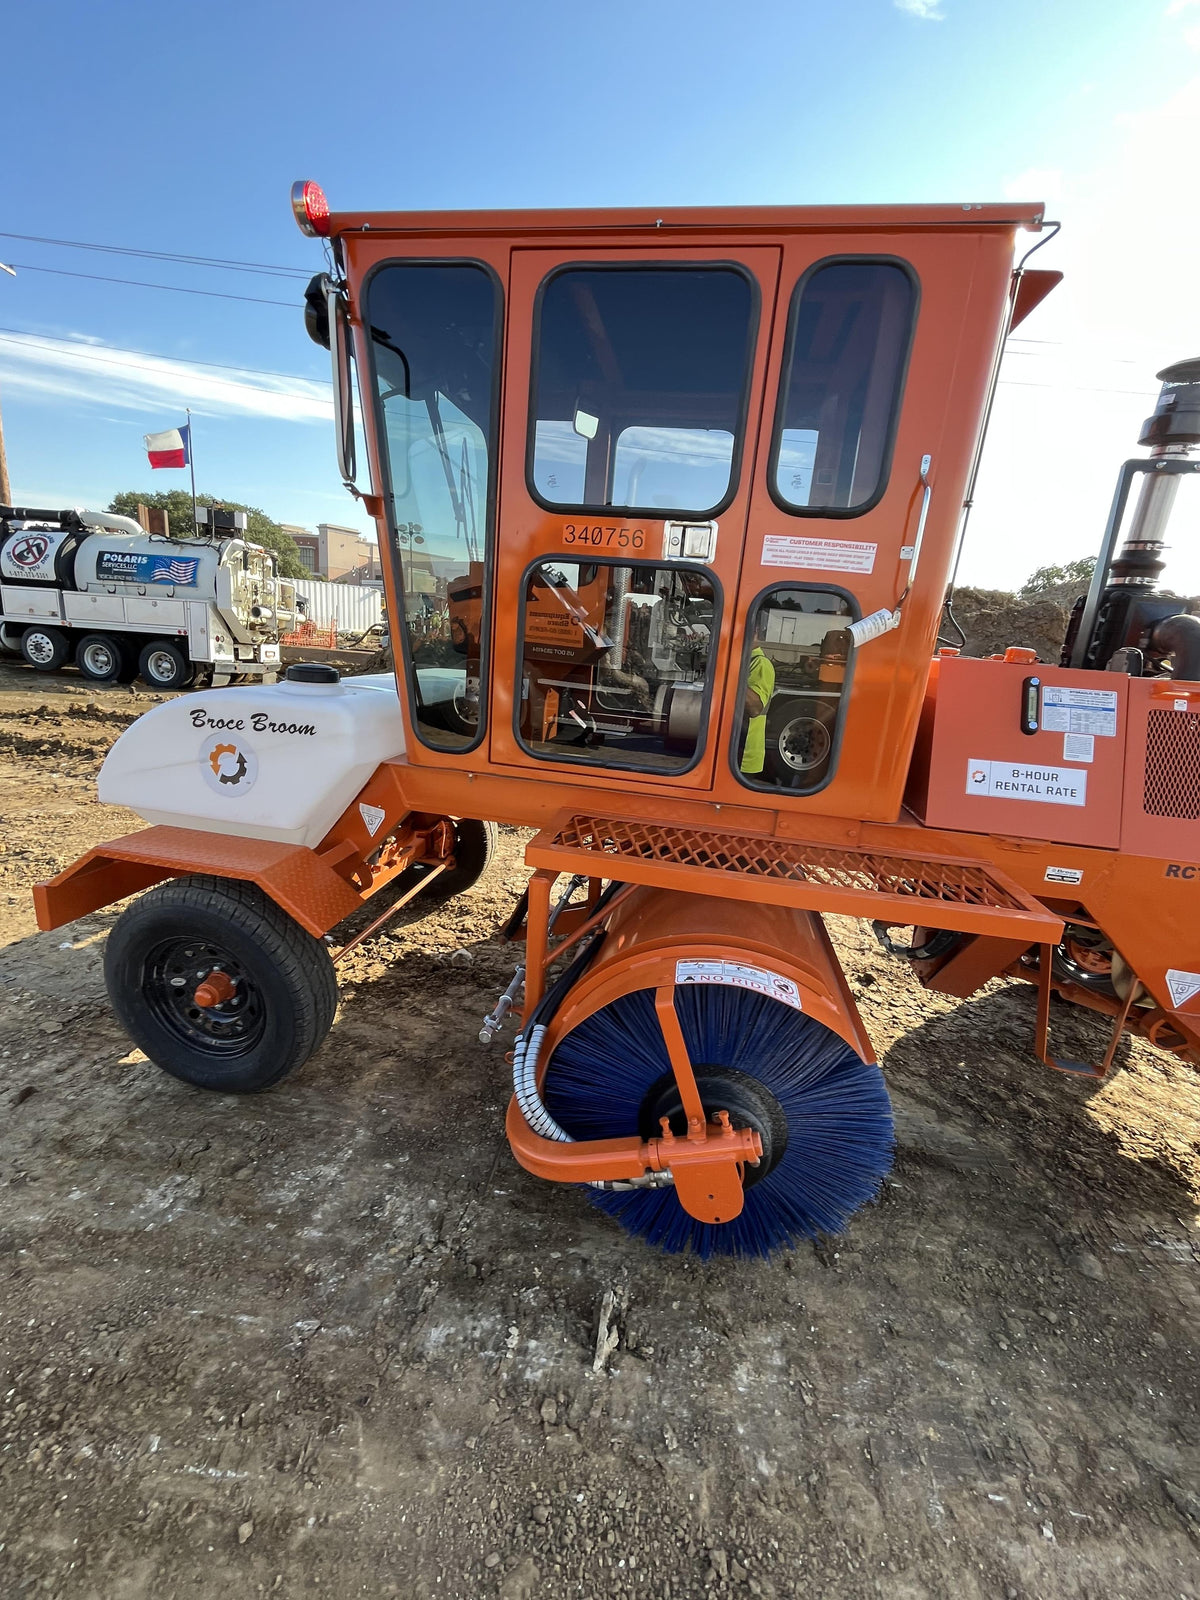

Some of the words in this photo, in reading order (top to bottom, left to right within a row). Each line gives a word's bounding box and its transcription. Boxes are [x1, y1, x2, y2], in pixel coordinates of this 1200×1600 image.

[564, 524, 645, 548] 340756
[789, 538, 823, 547] CUSTOMER
[823, 541, 876, 551] RESPONSIBILITY
[103, 553, 148, 564] POLARIS
[189, 708, 245, 731] Broce
[250, 712, 317, 736] Broom
[1012, 769, 1059, 782] 8-HOUR
[995, 781, 1042, 794] RENTAL
[1046, 786, 1077, 798] RATE
[1165, 864, 1200, 880] RC
[731, 977, 795, 1005] RIDERS
